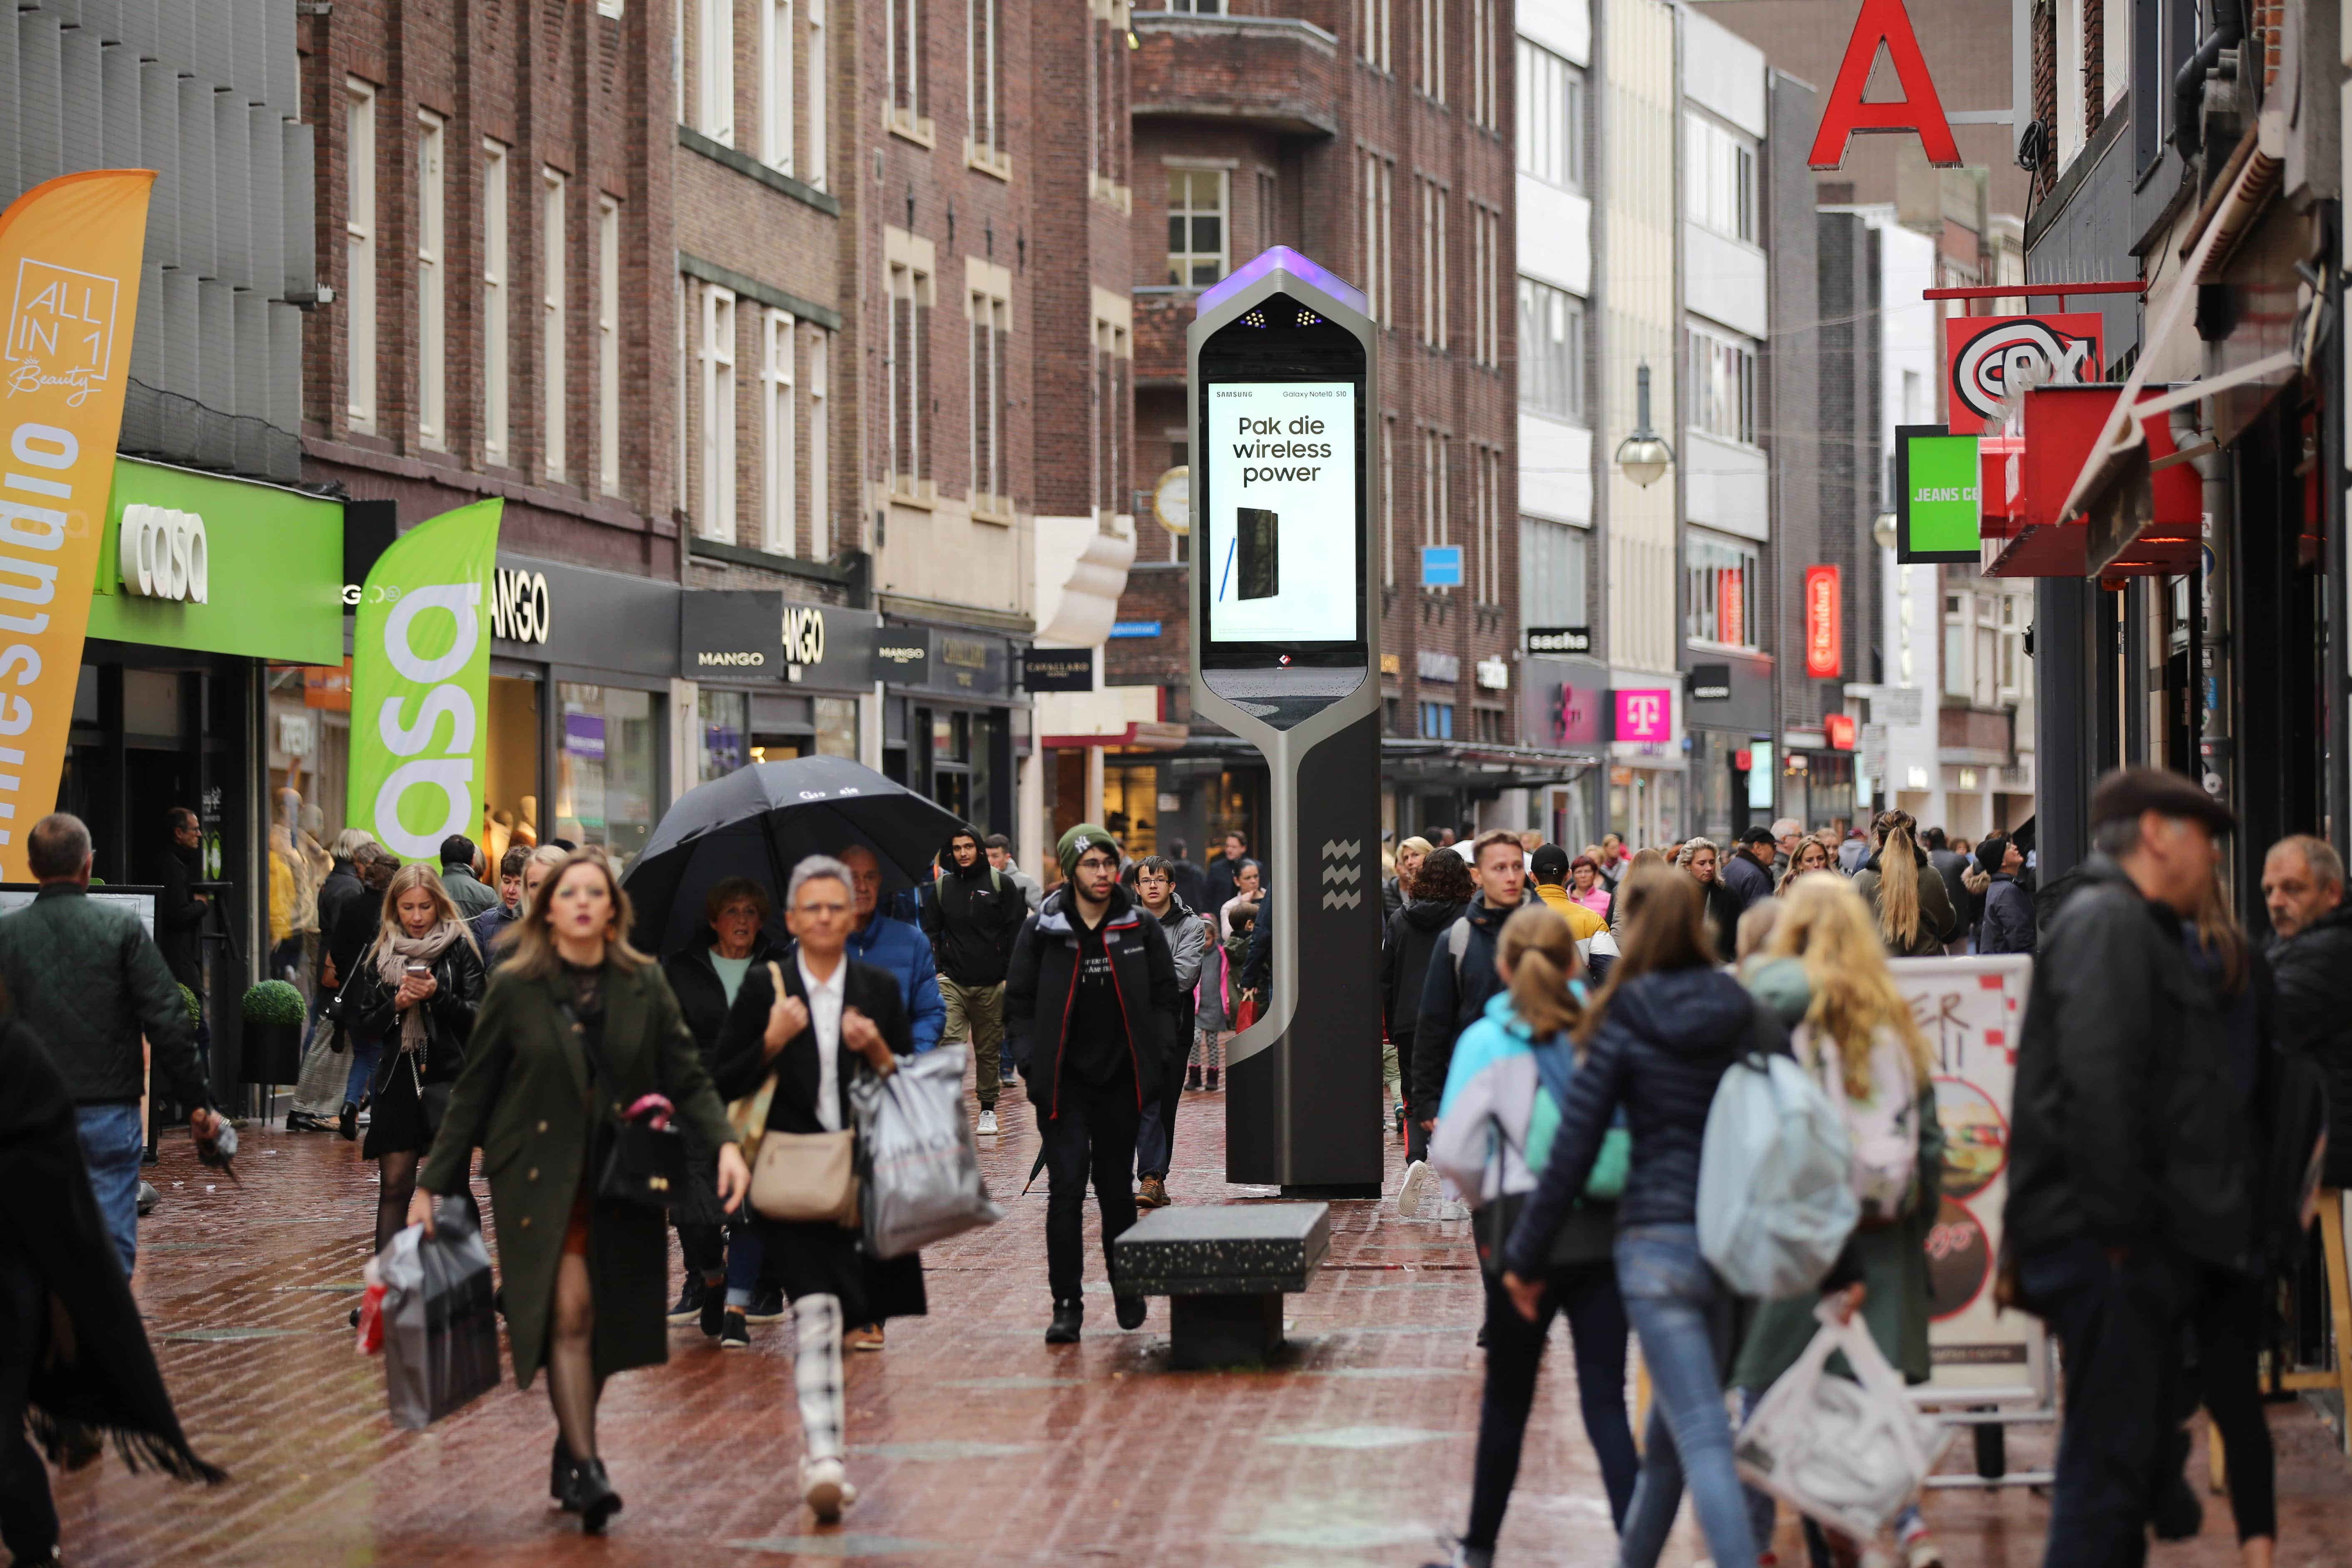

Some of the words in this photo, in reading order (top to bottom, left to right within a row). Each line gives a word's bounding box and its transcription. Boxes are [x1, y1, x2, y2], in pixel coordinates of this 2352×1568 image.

[1808, 0, 1963, 171] A
[26, 280, 102, 325] ALL
[19, 315, 59, 356] IN
[83, 331, 100, 366] 1
[6, 364, 102, 407] Beauty
[1239, 416, 1281, 435] Pak
[1288, 415, 1325, 435] die
[1232, 439, 1331, 458] wireless
[1244, 467, 1321, 488] power
[1914, 487, 1959, 502] JEANS
[120, 504, 208, 605] casa
[490, 566, 551, 645] ANGO
[879, 647, 925, 659] MANGO
[1529, 631, 1588, 650] sacha
[698, 651, 765, 666] MANGO
[1627, 695, 1660, 736] T
